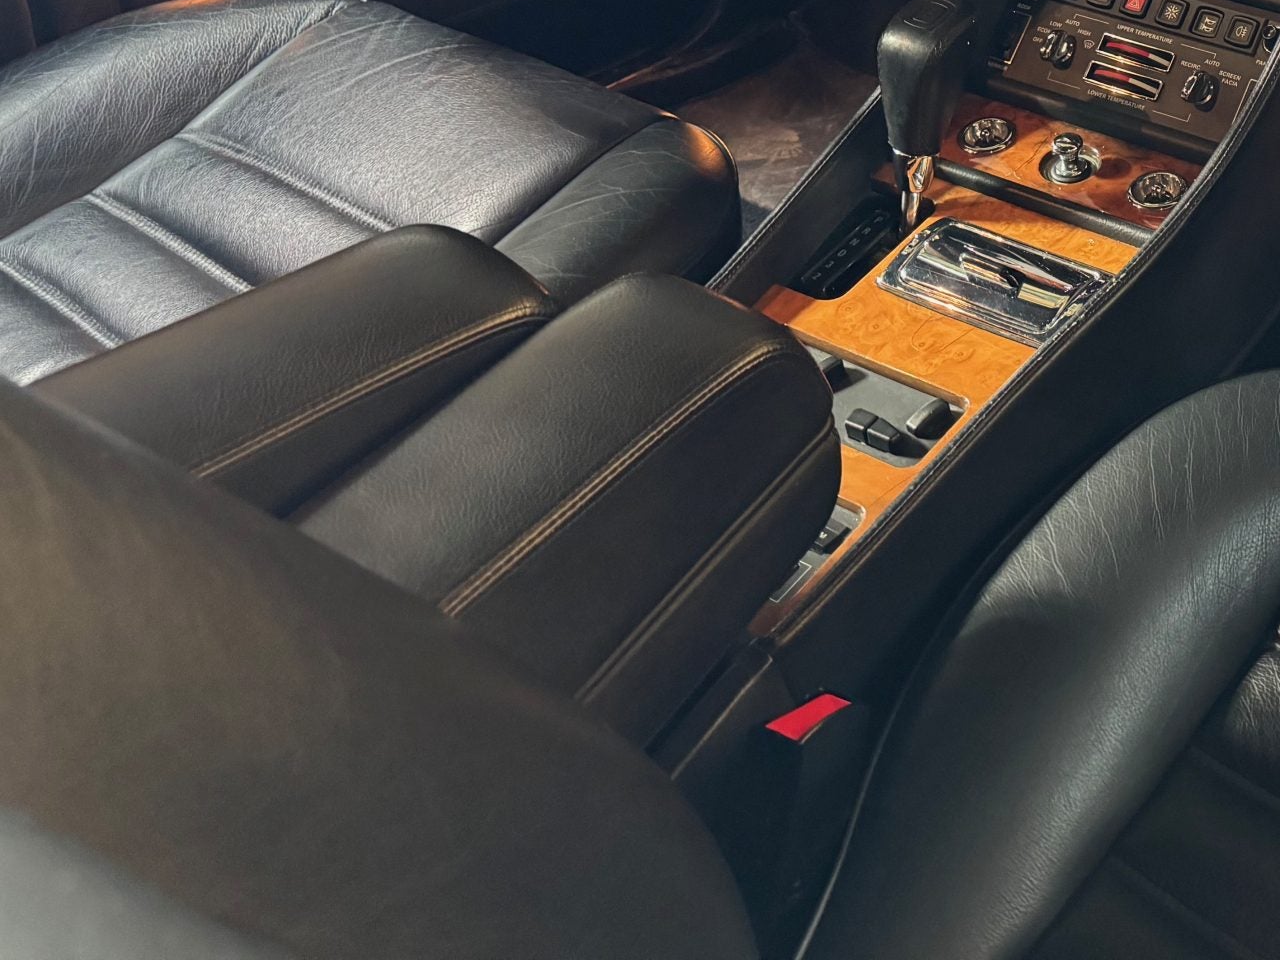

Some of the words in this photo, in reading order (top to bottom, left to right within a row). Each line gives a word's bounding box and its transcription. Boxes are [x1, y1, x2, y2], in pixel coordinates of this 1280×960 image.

[1050, 20, 1063, 28] LOW
[1065, 19, 1080, 27] AUTO
[1116, 24, 1135, 33] UPPER
[1135, 29, 1174, 45] TEMPERATURE
[1204, 59, 1221, 67] AUTO
[1218, 70, 1242, 81] SCREEN
[1087, 89, 1107, 99] LOWER
[1107, 95, 1145, 111] TEMPERATURE
